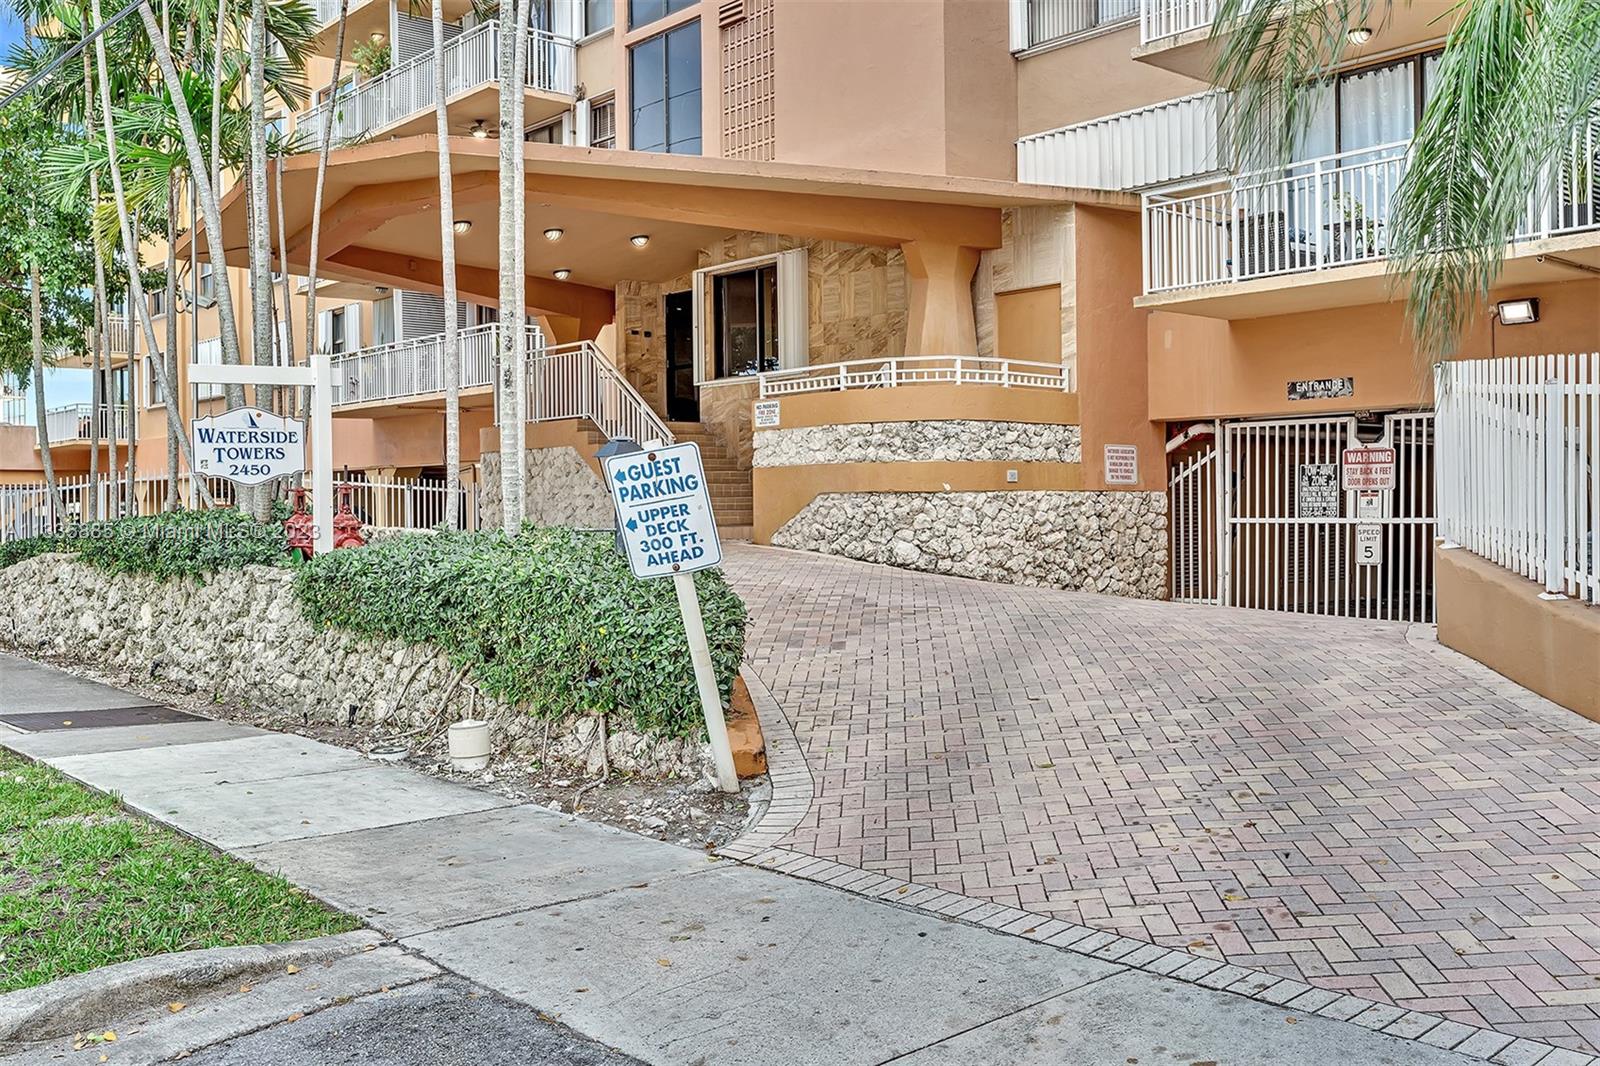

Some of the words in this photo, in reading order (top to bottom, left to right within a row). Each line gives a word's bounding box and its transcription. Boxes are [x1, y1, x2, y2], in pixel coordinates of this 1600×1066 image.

[1296, 380, 1343, 392] ENTRANCE
[198, 428, 298, 444] WATERSIDE
[213, 448, 286, 463] TOWERS
[1347, 452, 1392, 463] WARNING
[229, 464, 271, 476] 2450
[628, 457, 680, 481] GUEST
[619, 474, 699, 503] PARKING
[1311, 476, 1328, 486] ZONE
[637, 503, 690, 523] UPPER
[645, 519, 690, 537] DECK
[640, 537, 673, 552] 300
[680, 532, 704, 546] FT.
[647, 546, 704, 567] AHEAD
[1364, 546, 1373, 559] 5
